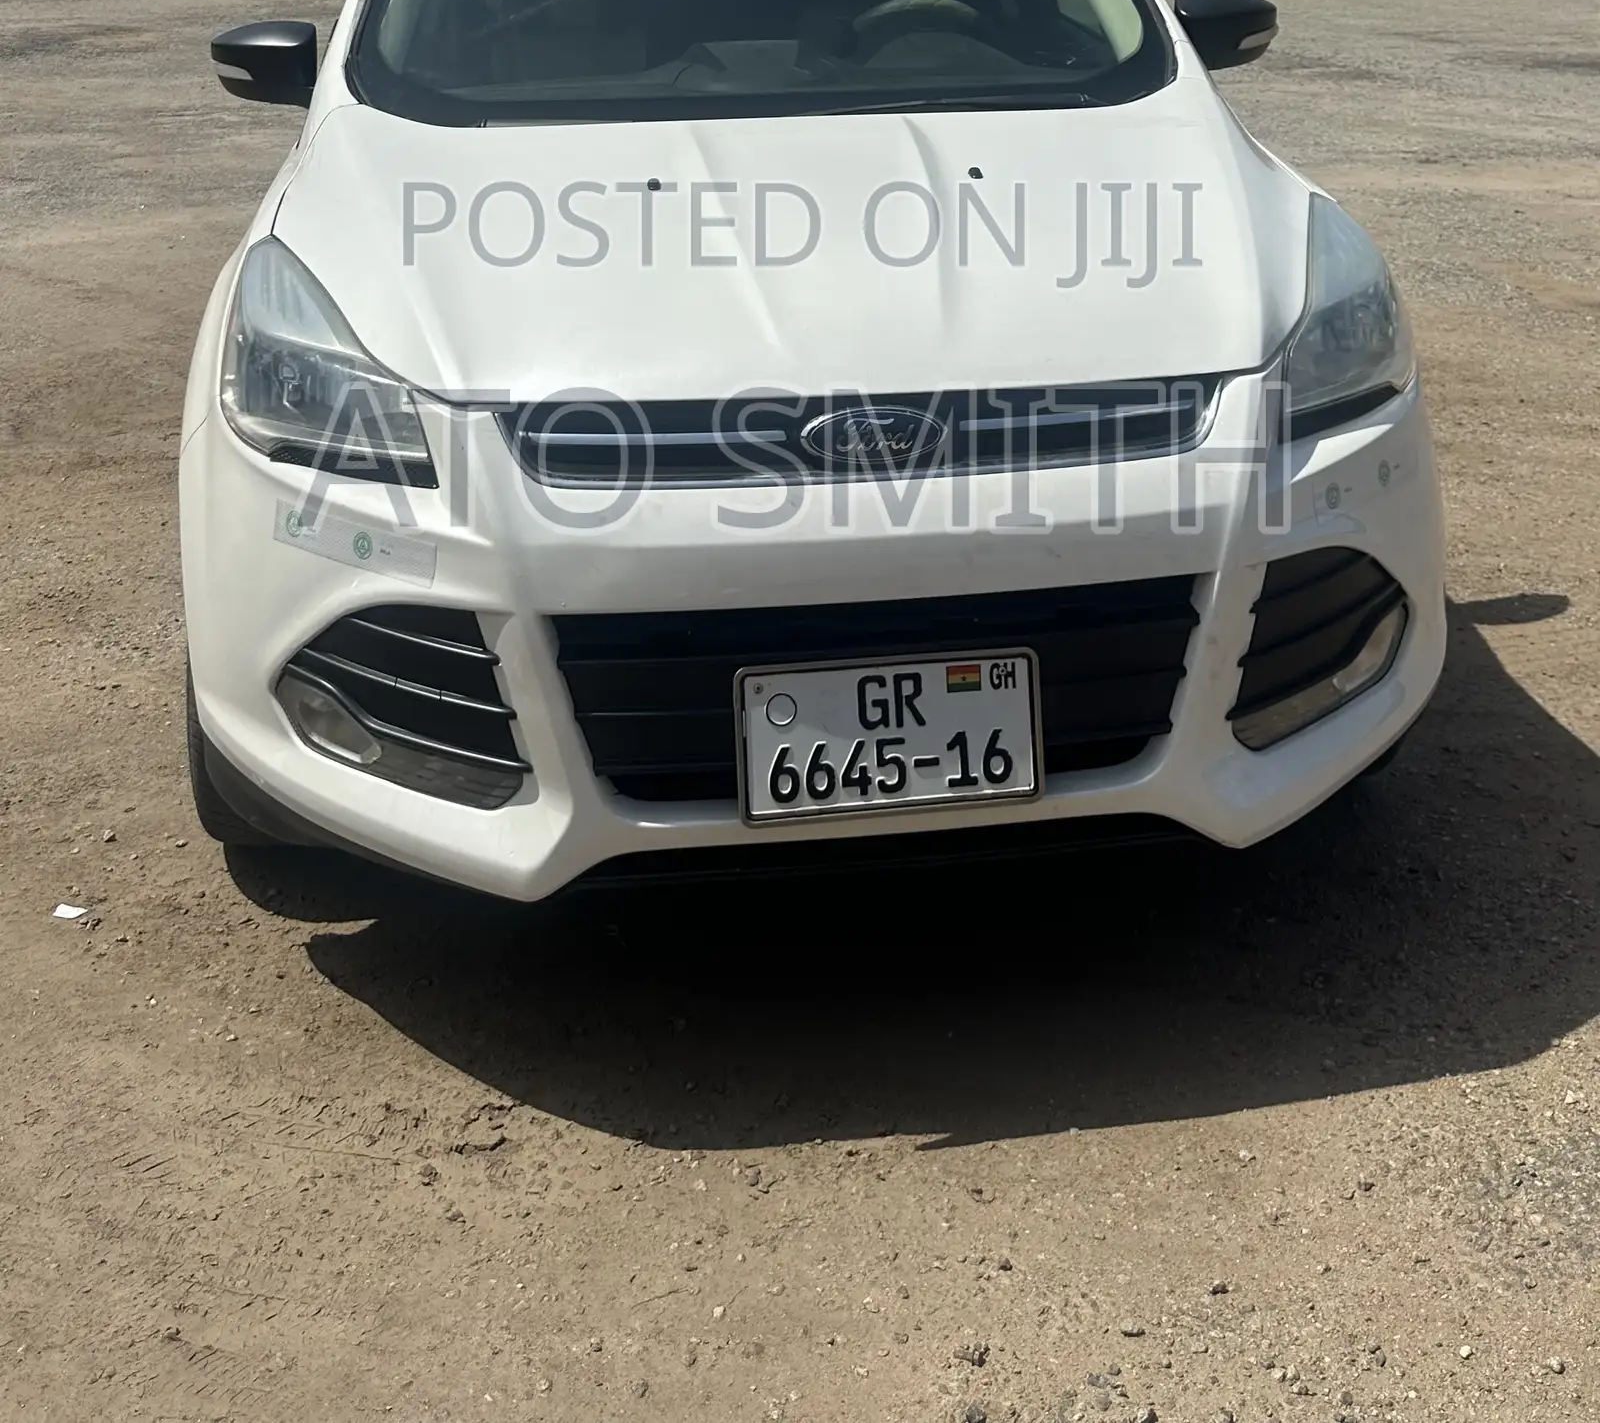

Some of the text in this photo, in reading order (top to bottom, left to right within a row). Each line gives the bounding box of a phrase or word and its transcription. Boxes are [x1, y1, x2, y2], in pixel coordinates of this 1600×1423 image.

[836, 417, 915, 453] Ford
[988, 661, 1017, 690] GH
[856, 672, 927, 730] GR
[768, 728, 1014, 804] 6645-16
